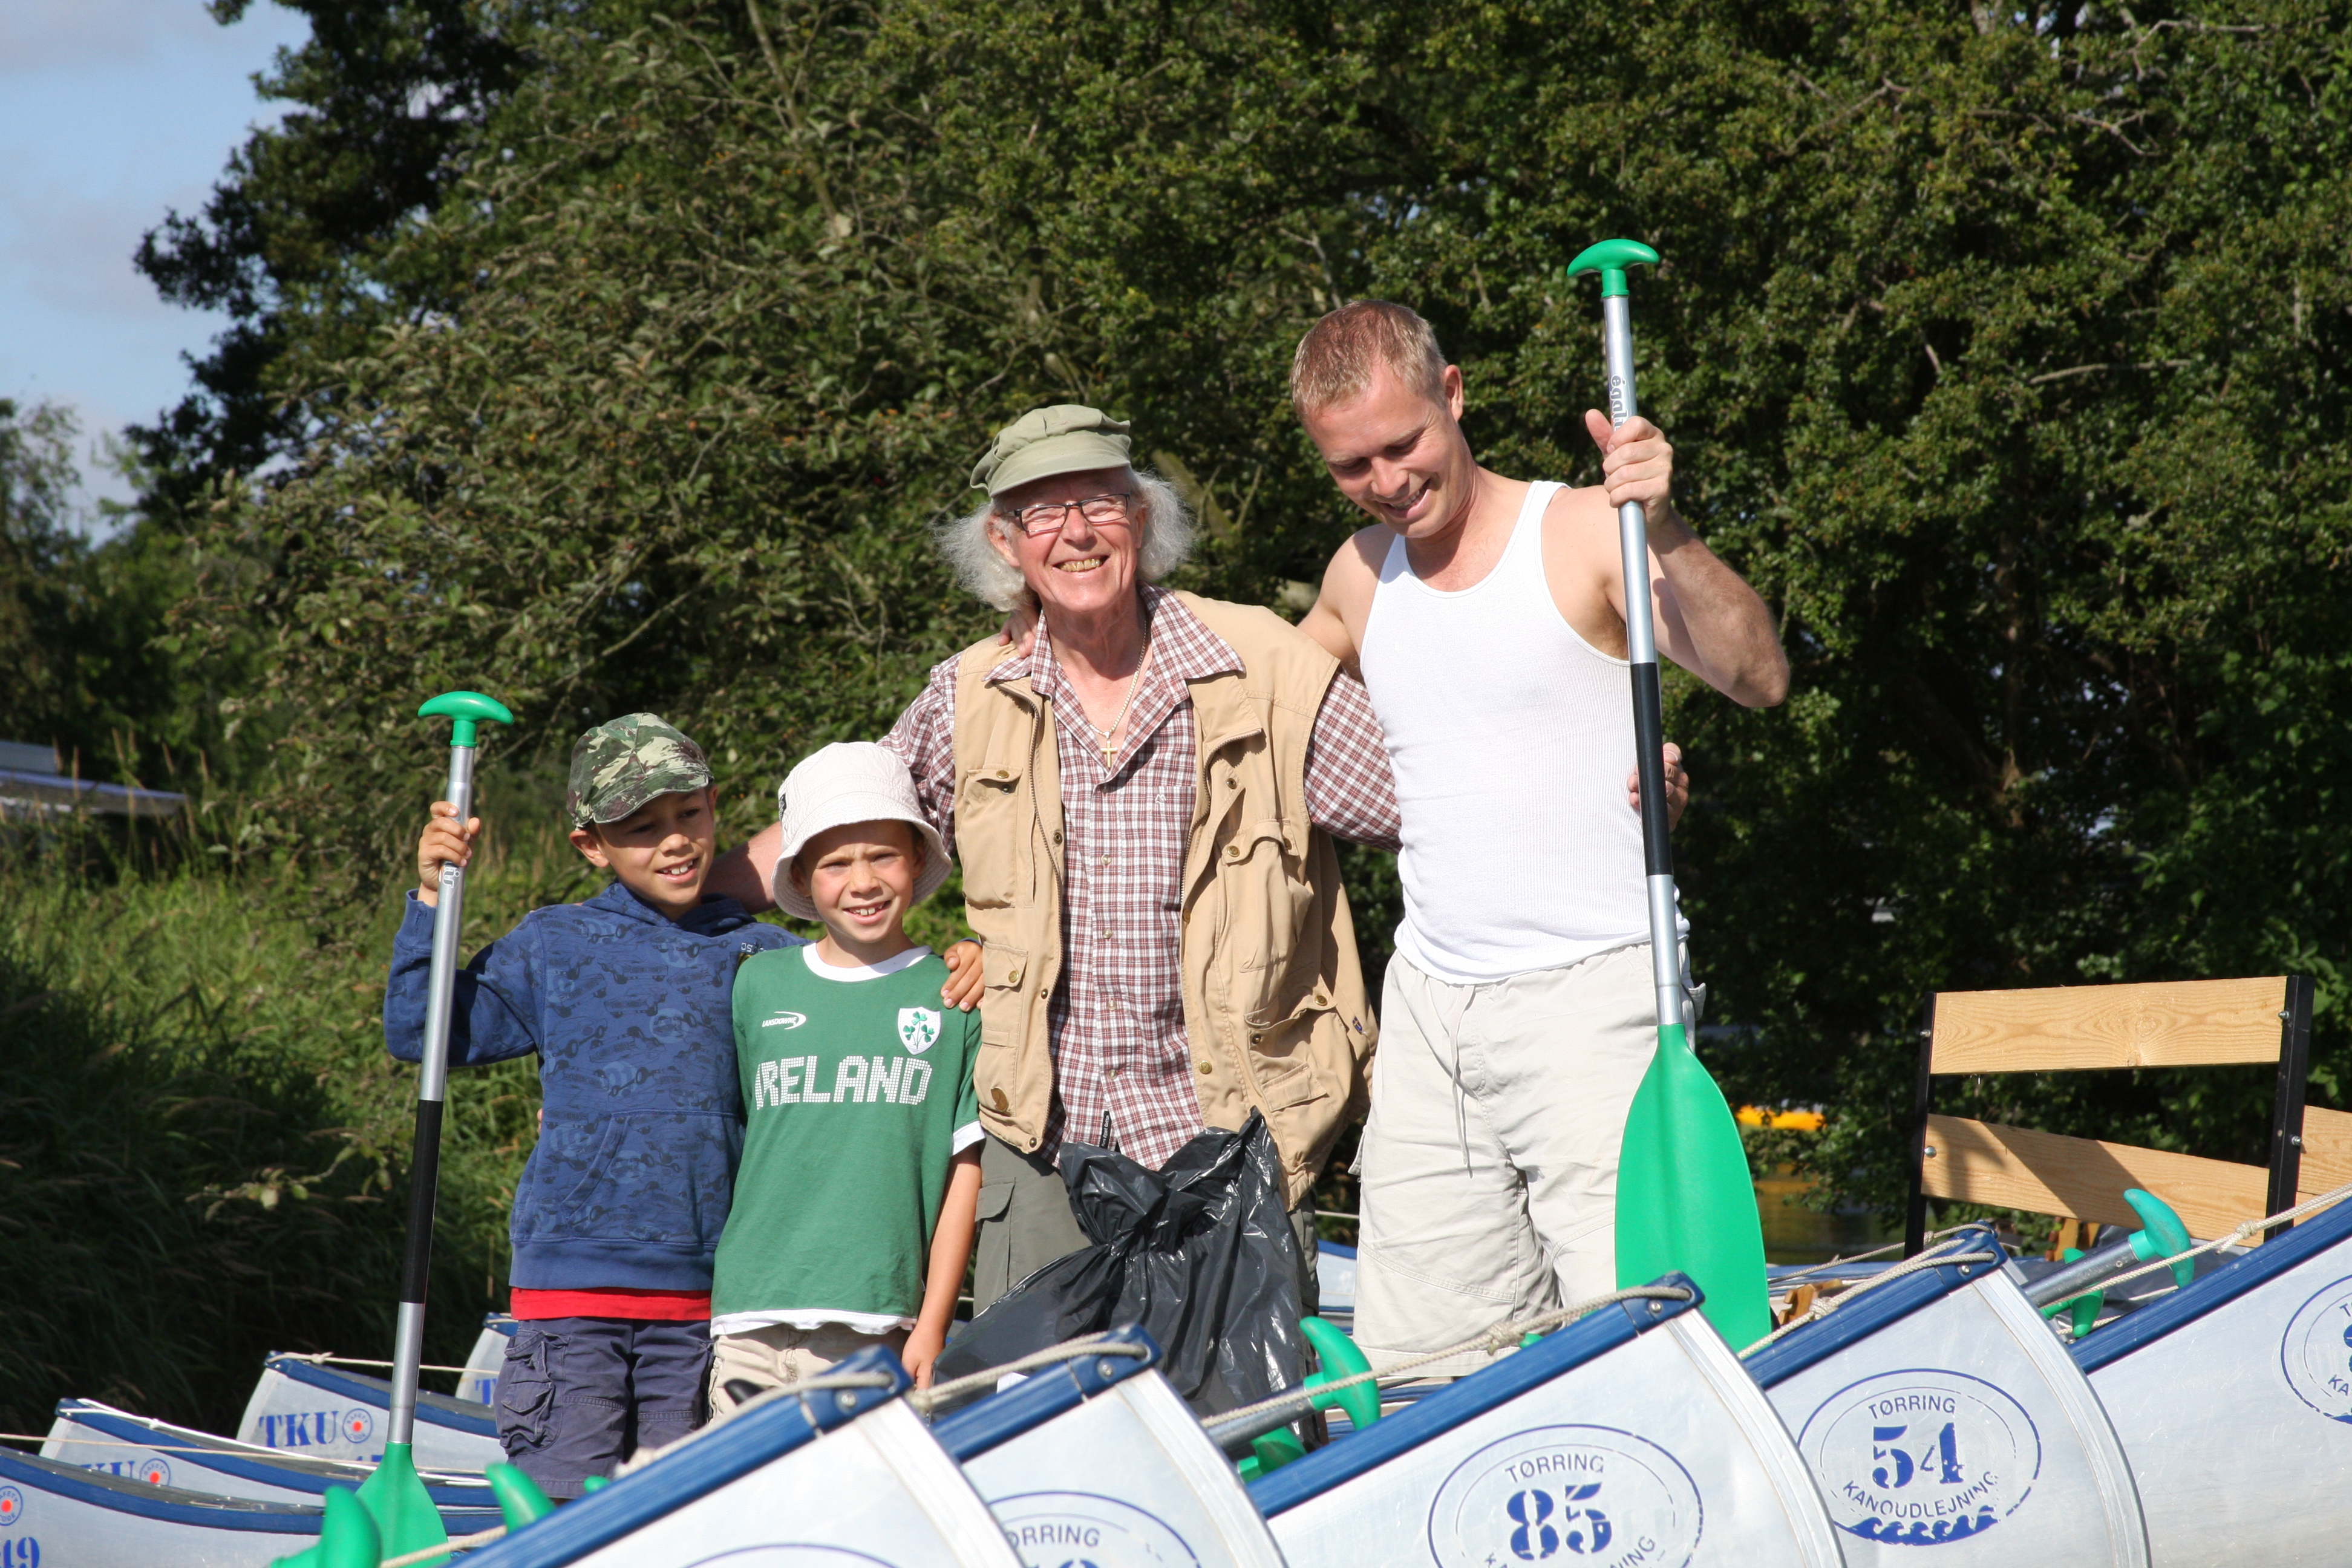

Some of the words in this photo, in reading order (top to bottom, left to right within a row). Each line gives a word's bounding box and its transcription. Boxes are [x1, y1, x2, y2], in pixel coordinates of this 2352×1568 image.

[762, 1016, 797, 1028] LANSDOWNE
[755, 1055, 933, 1111] IRELAND
[258, 1410, 339, 1448] TKU
[1872, 1422, 1966, 1489] 54
[1506, 1481, 1613, 1561] 85
